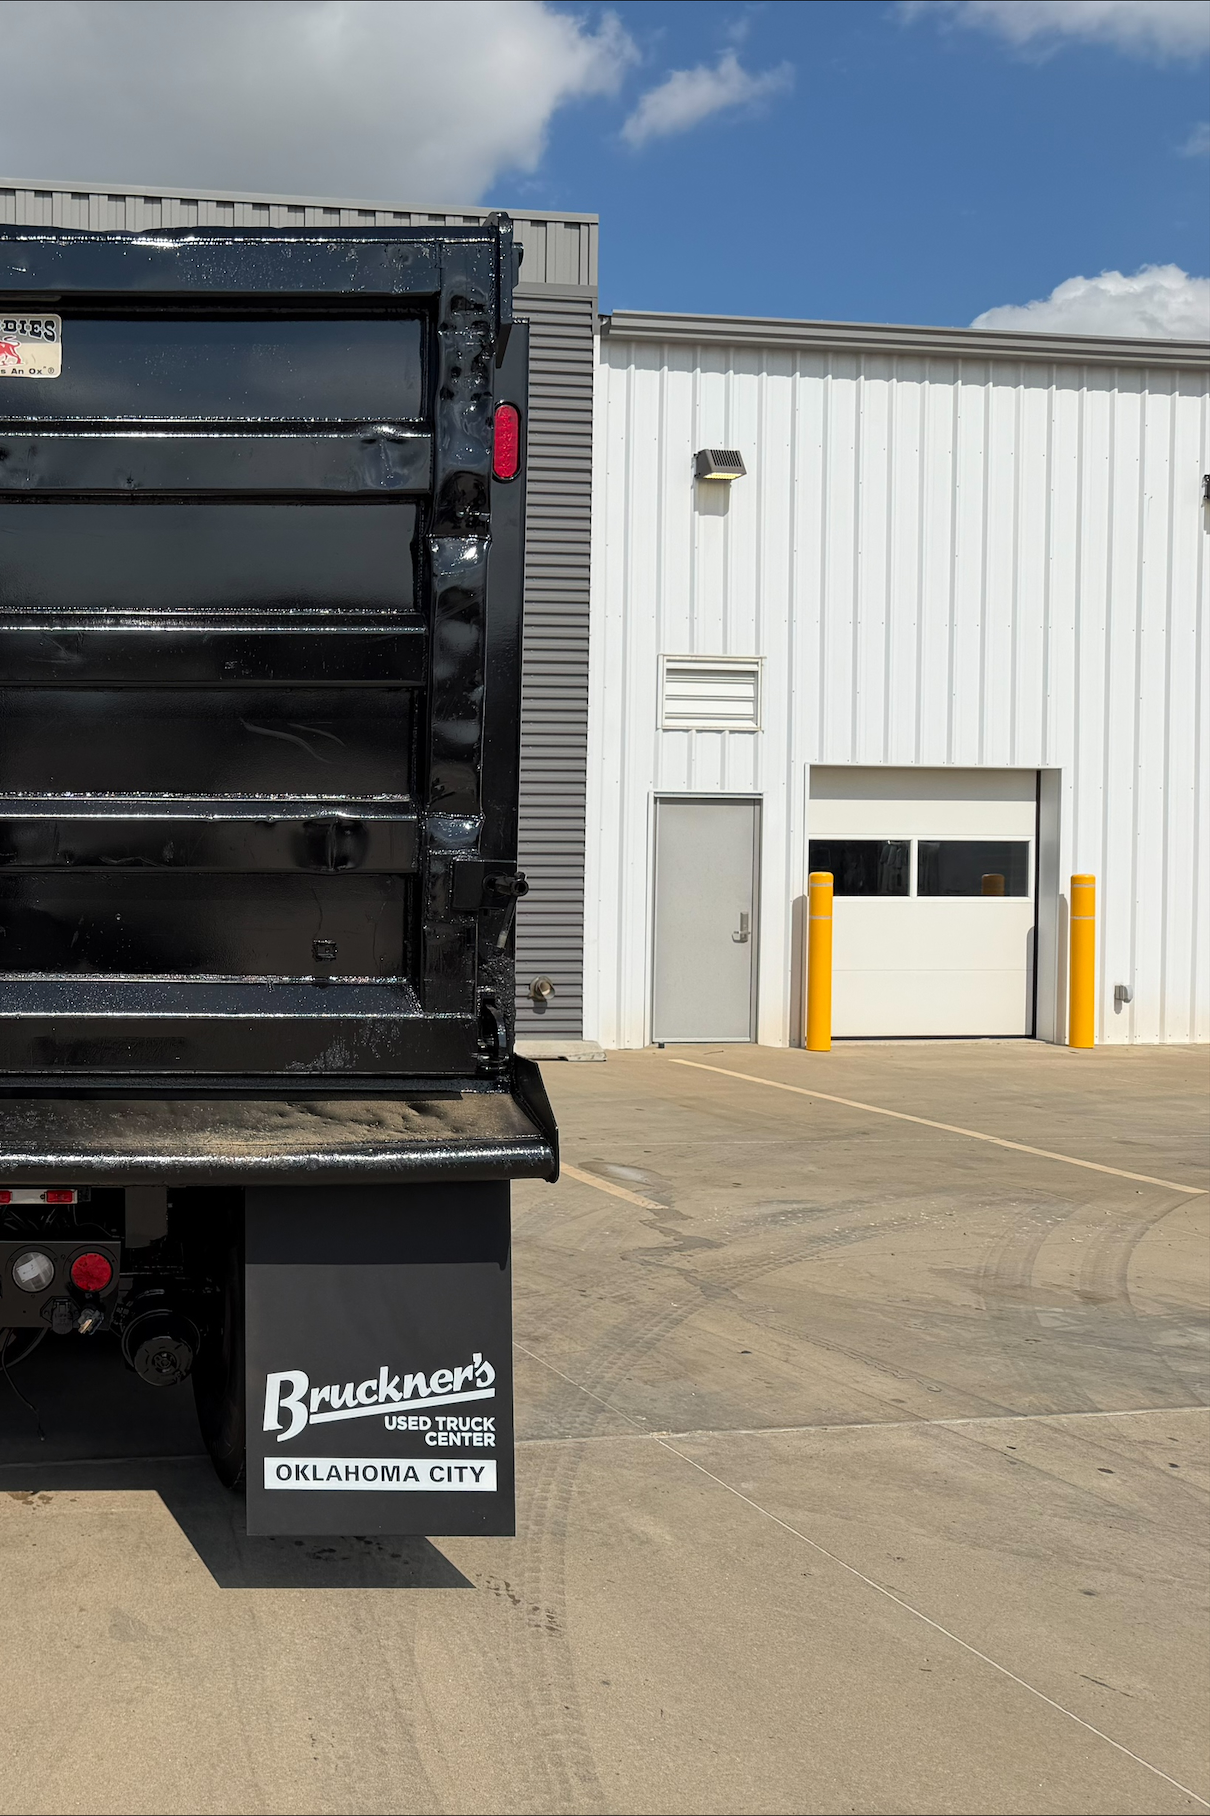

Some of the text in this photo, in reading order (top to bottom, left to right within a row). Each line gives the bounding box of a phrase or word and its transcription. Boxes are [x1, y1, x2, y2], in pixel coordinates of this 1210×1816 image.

[263, 1352, 496, 1442] Bruckner's
[384, 1415, 496, 1432] USED TRUCK
[424, 1432, 496, 1447] CENTER
[275, 1463, 486, 1483] OKLAHOMA CITY
